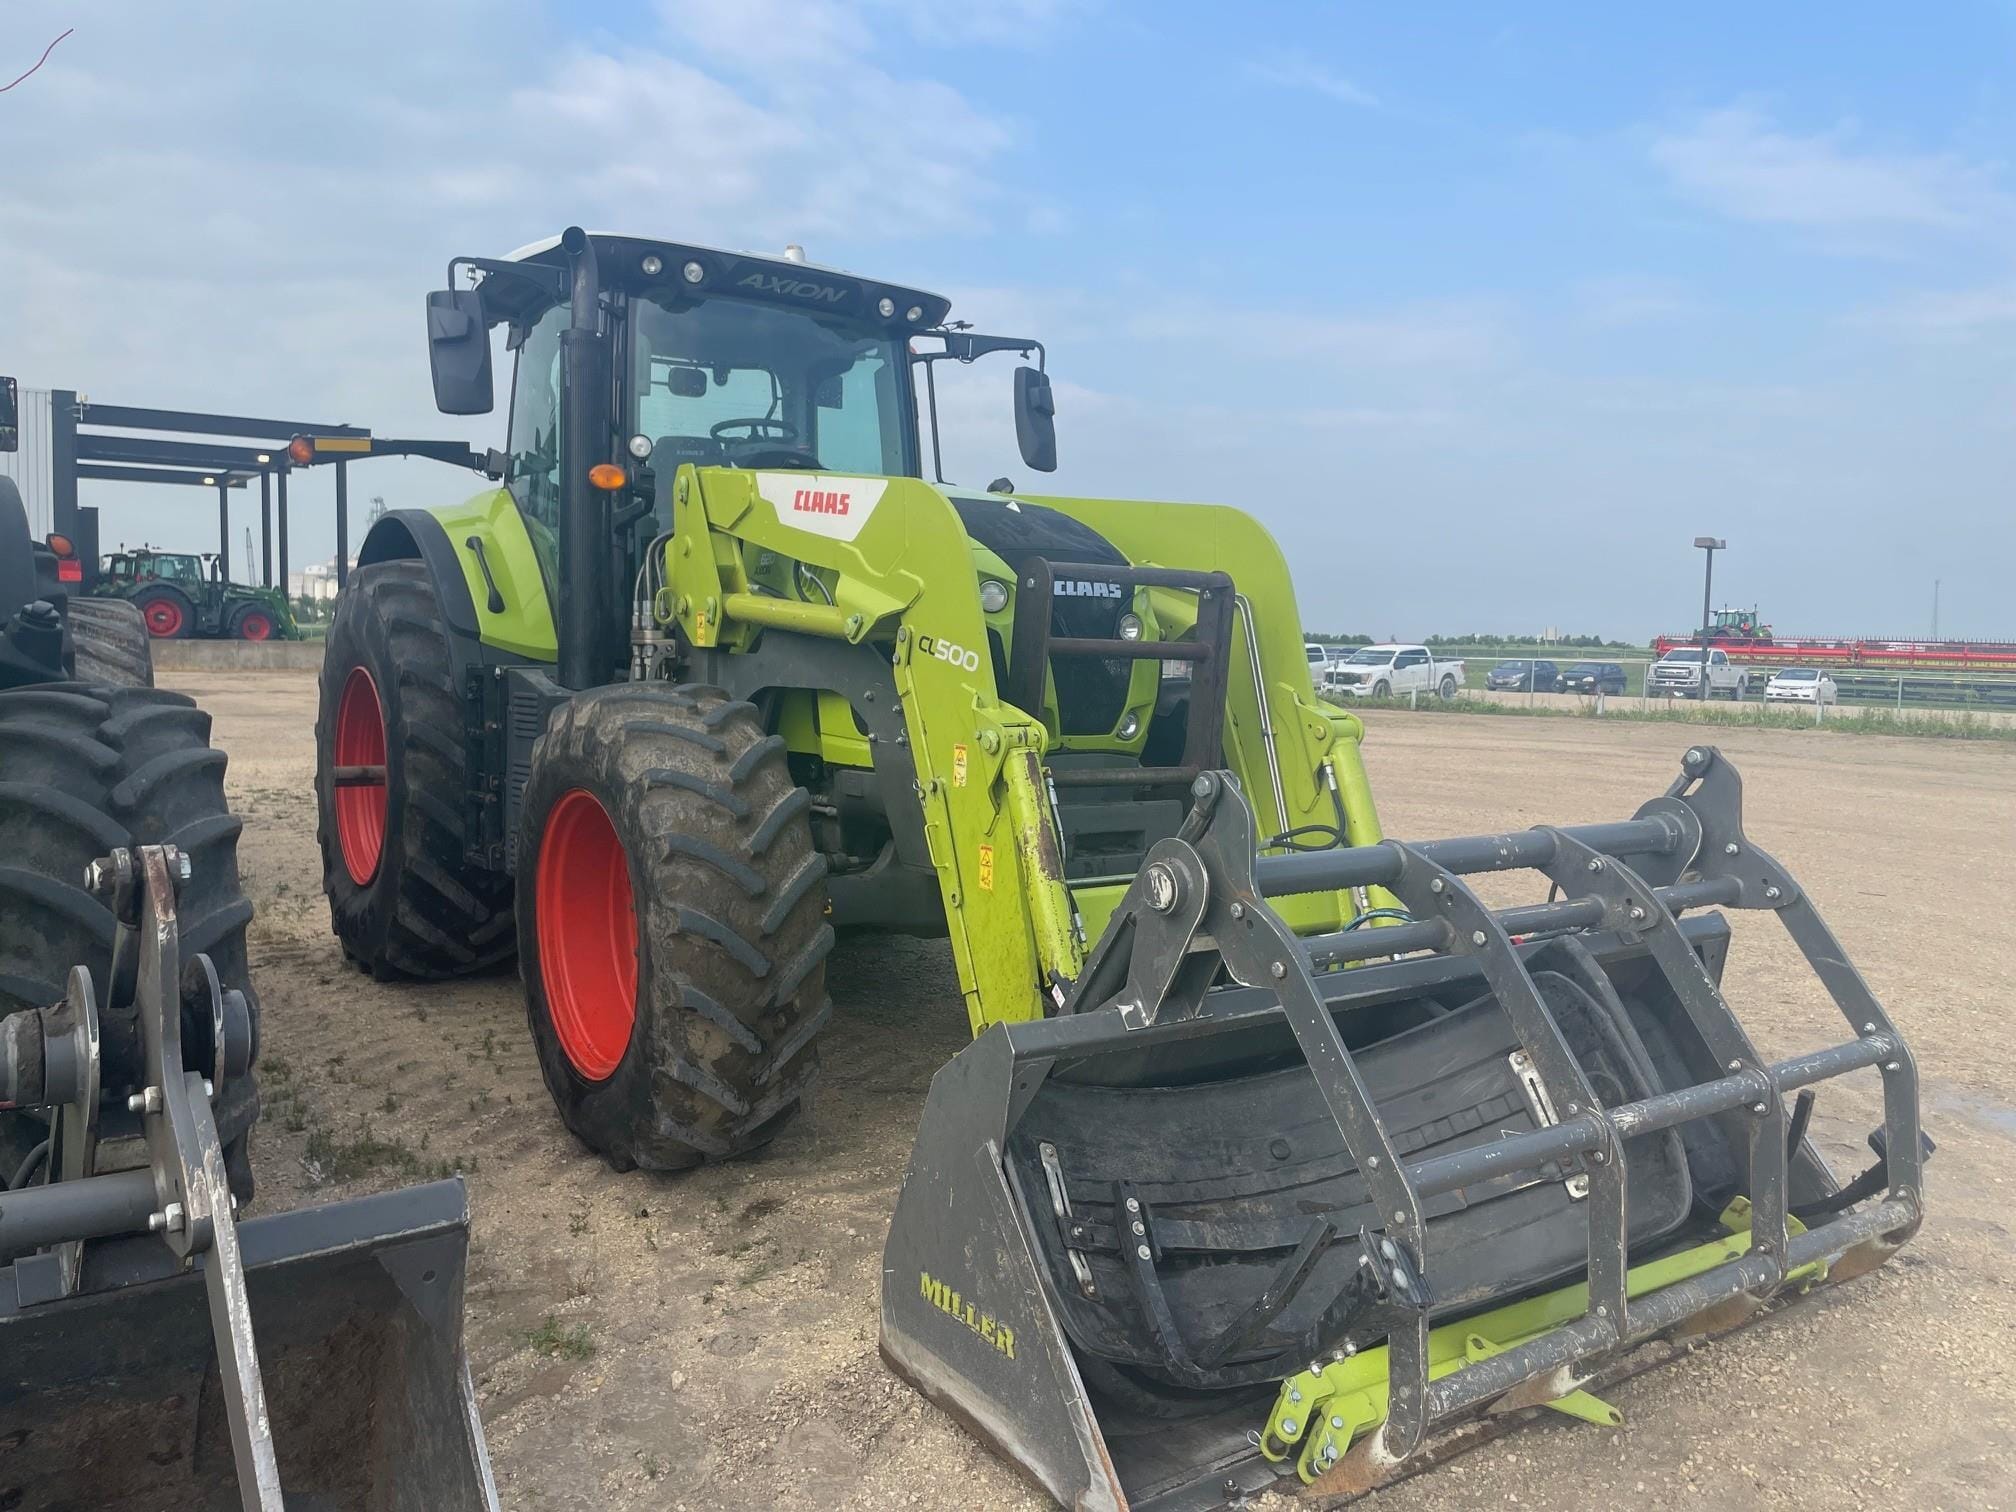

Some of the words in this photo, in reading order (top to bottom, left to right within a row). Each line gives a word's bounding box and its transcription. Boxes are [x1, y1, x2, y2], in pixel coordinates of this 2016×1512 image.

[736, 273, 848, 302] AXION
[793, 490, 851, 516] CLAAS
[1053, 580, 1122, 599] CLAAS
[920, 1271, 1015, 1360] MILLER
